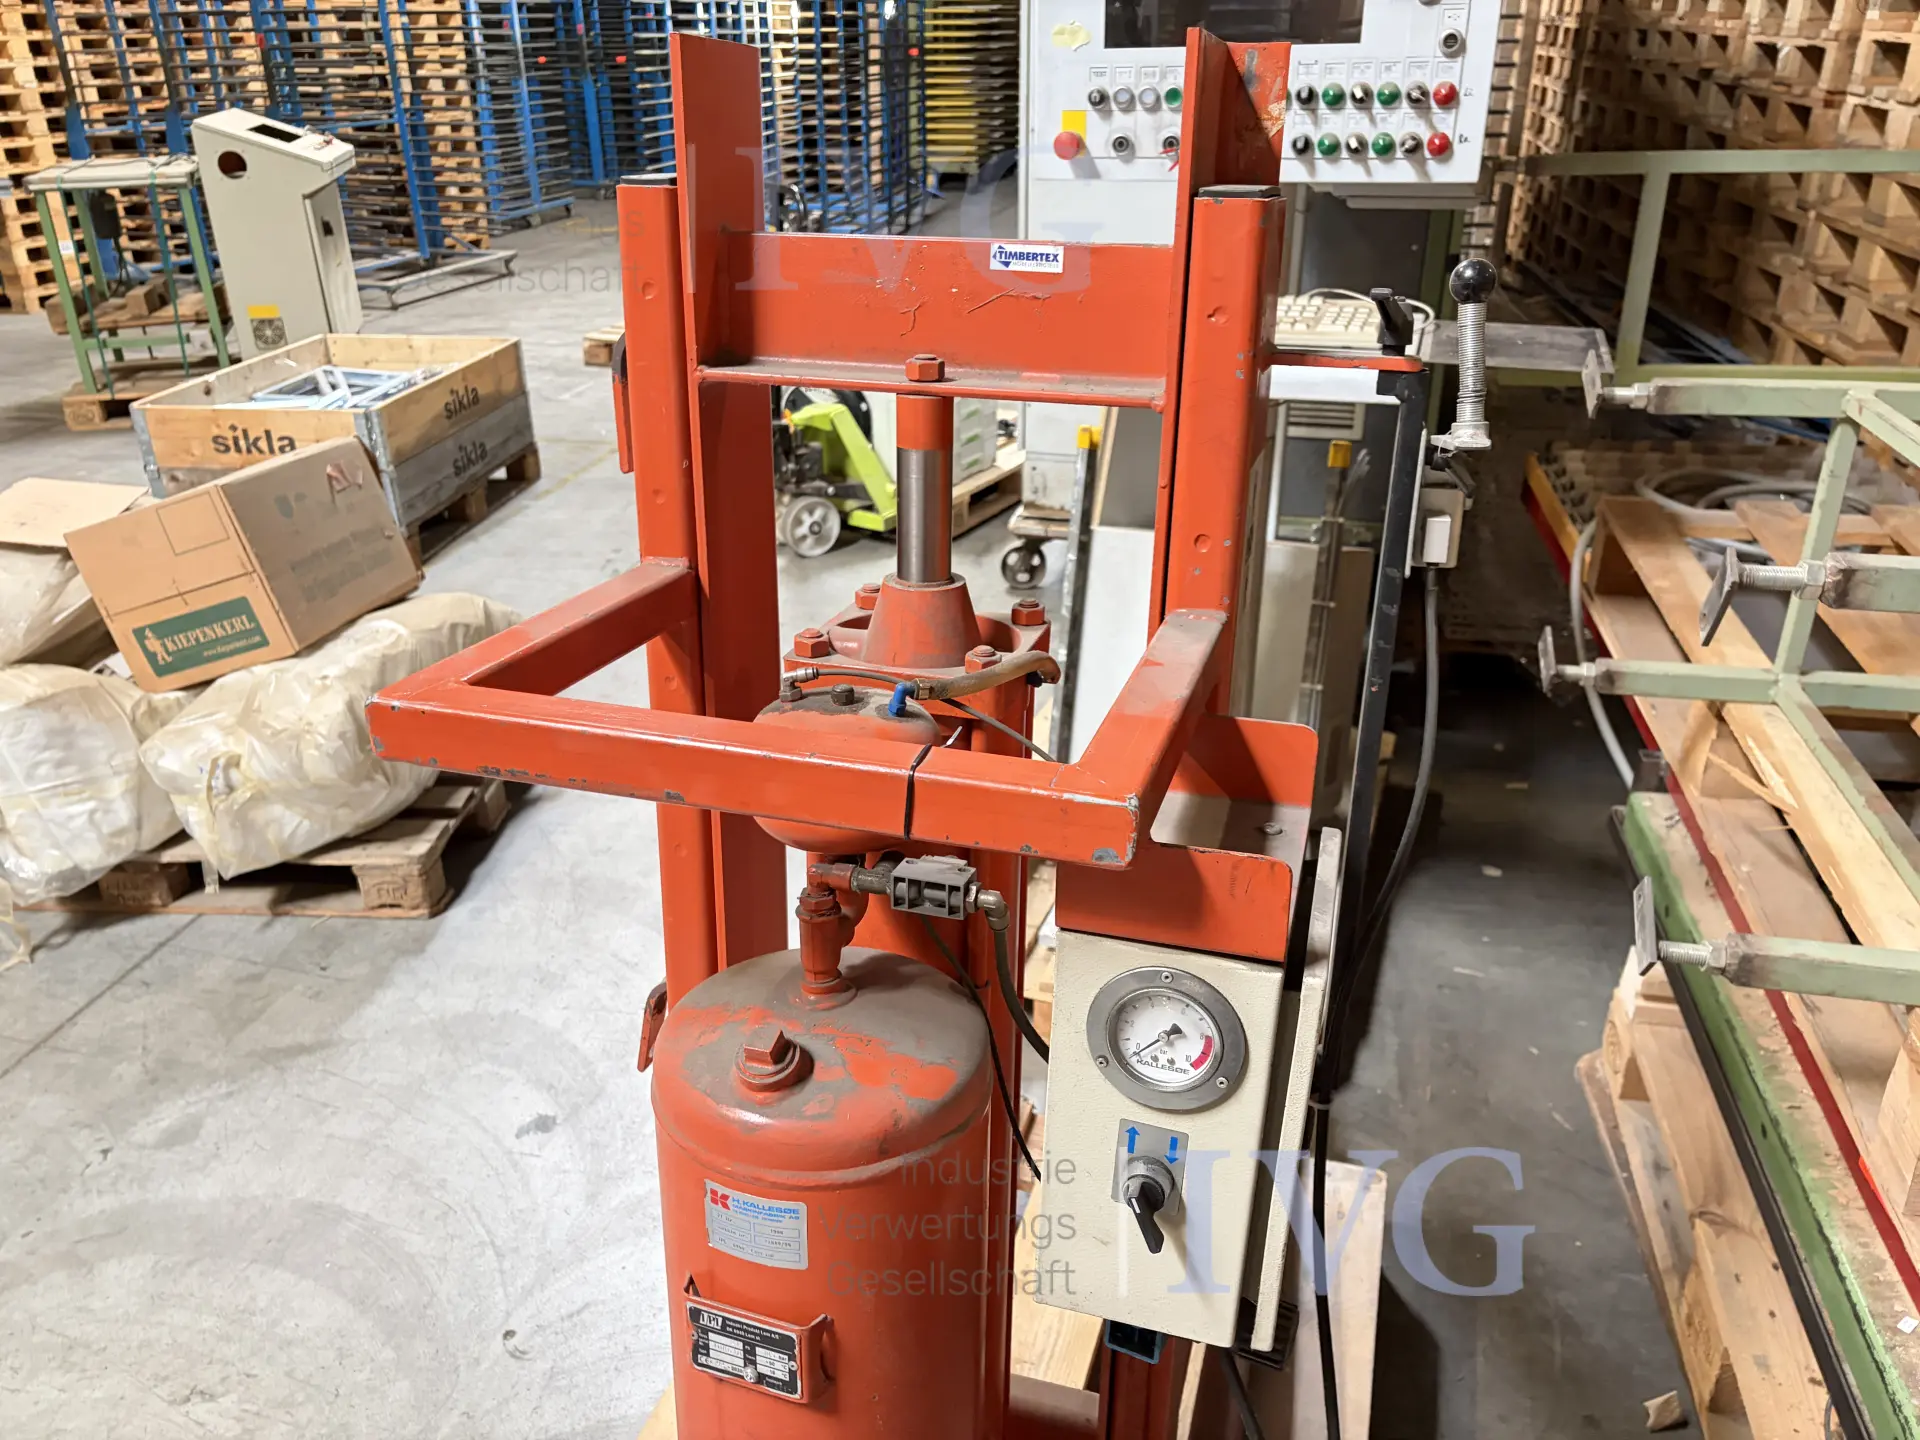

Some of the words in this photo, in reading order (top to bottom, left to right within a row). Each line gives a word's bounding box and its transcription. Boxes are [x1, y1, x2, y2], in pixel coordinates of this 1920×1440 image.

[998, 251, 1059, 263] TIMBERTEX
[444, 386, 481, 420] sikla
[211, 424, 297, 455] sikla
[453, 440, 488, 477] sikla
[163, 614, 256, 653] KIEPENKERL
[1135, 1042, 1141, 1051] 0
[1185, 1054, 1192, 1063] 10
